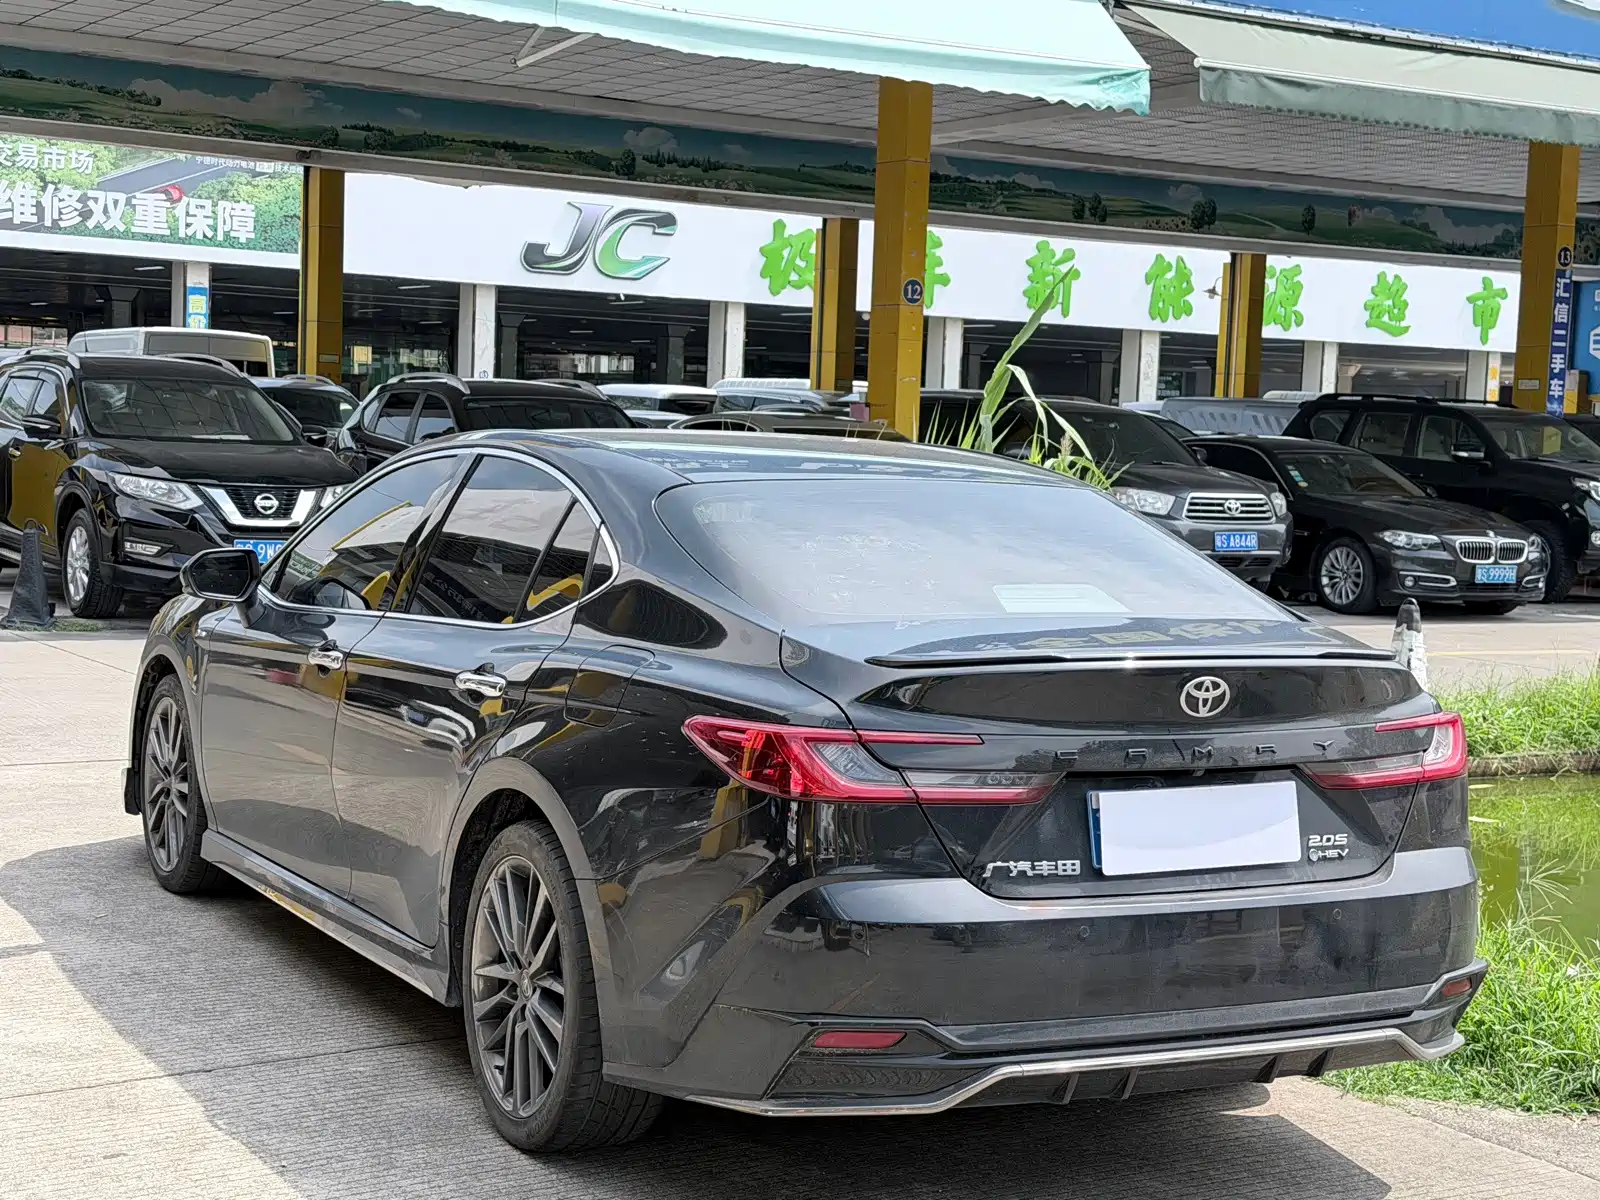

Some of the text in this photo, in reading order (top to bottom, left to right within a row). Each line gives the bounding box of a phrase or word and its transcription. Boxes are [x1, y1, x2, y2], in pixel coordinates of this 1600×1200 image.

[0, 141, 94, 174] 交易市场
[0, 178, 256, 243] 维修双重保障
[520, 201, 678, 280] JC
[1559, 250, 1571, 264] 13
[906, 284, 921, 299] 12
[1549, 278, 1570, 398] 汇信二手车
[983, 860, 1080, 877] 广汽丰田
